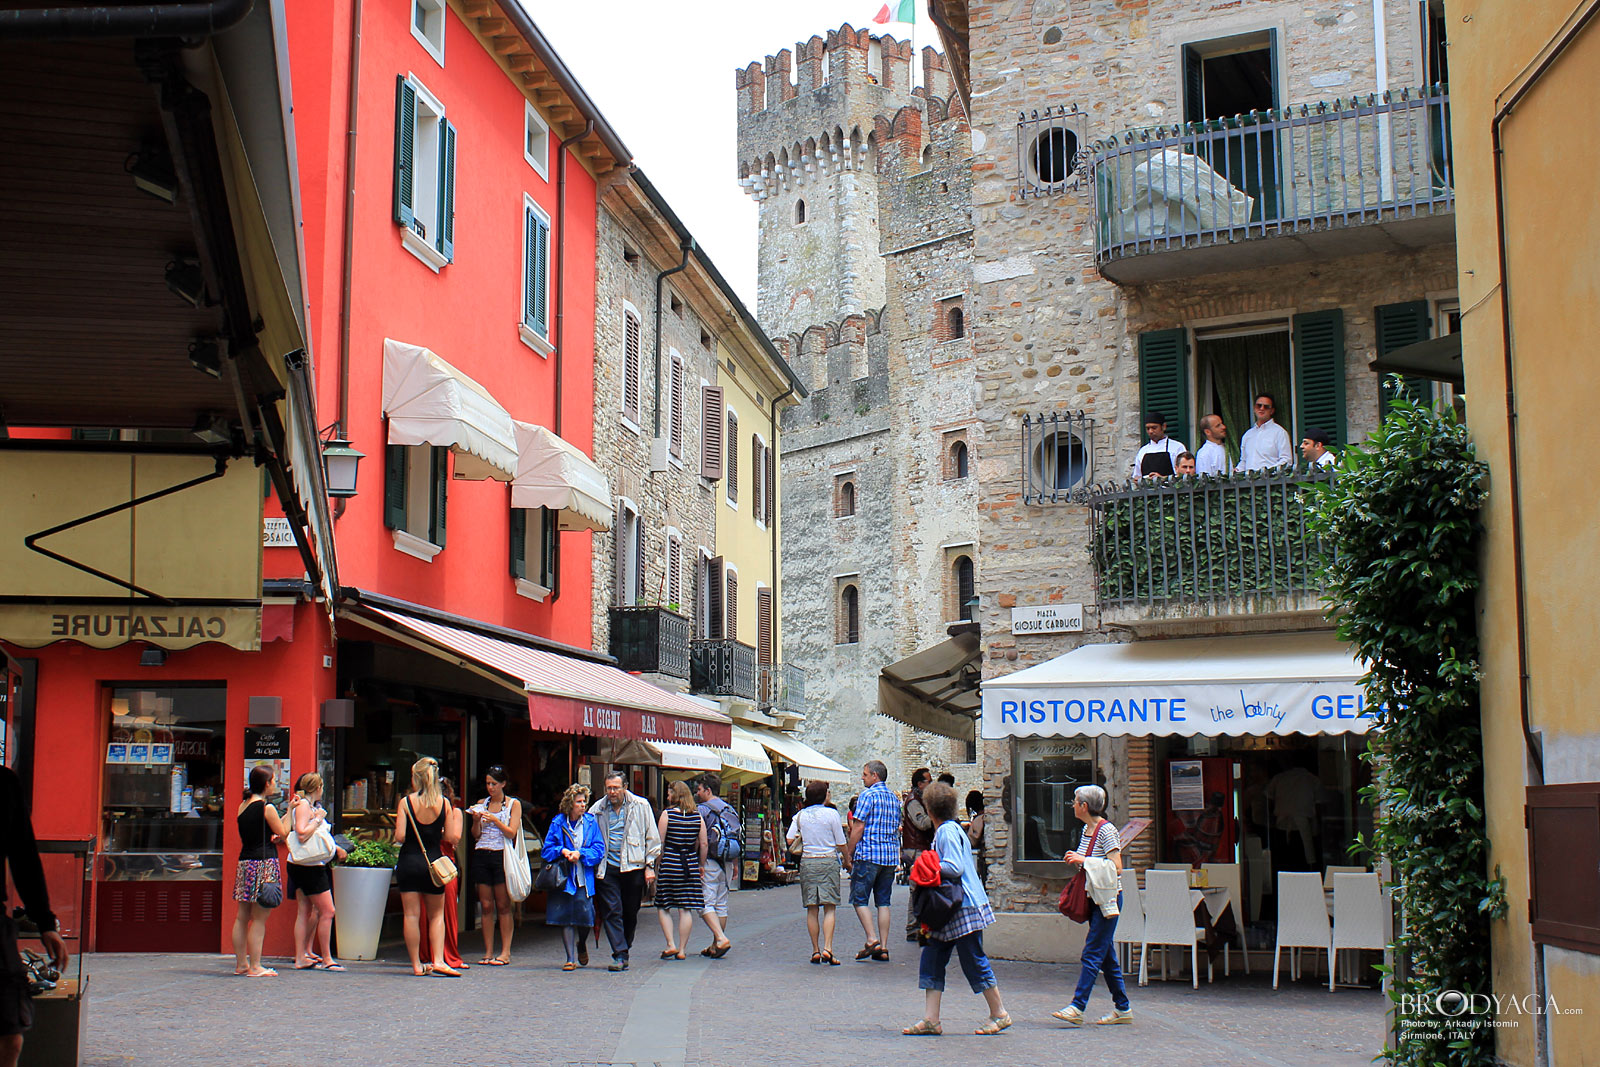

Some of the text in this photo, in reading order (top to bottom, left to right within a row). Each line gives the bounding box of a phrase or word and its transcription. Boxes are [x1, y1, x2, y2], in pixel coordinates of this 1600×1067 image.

[264, 533, 292, 542] OSAICI
[1045, 617, 1080, 629] CARDUCCI
[1001, 698, 1186, 723] RISTORANTE
[1210, 705, 1234, 722] the
[1239, 689, 1286, 728] bounty
[583, 706, 704, 740] AI CIGNI BAR PIZZERIA
